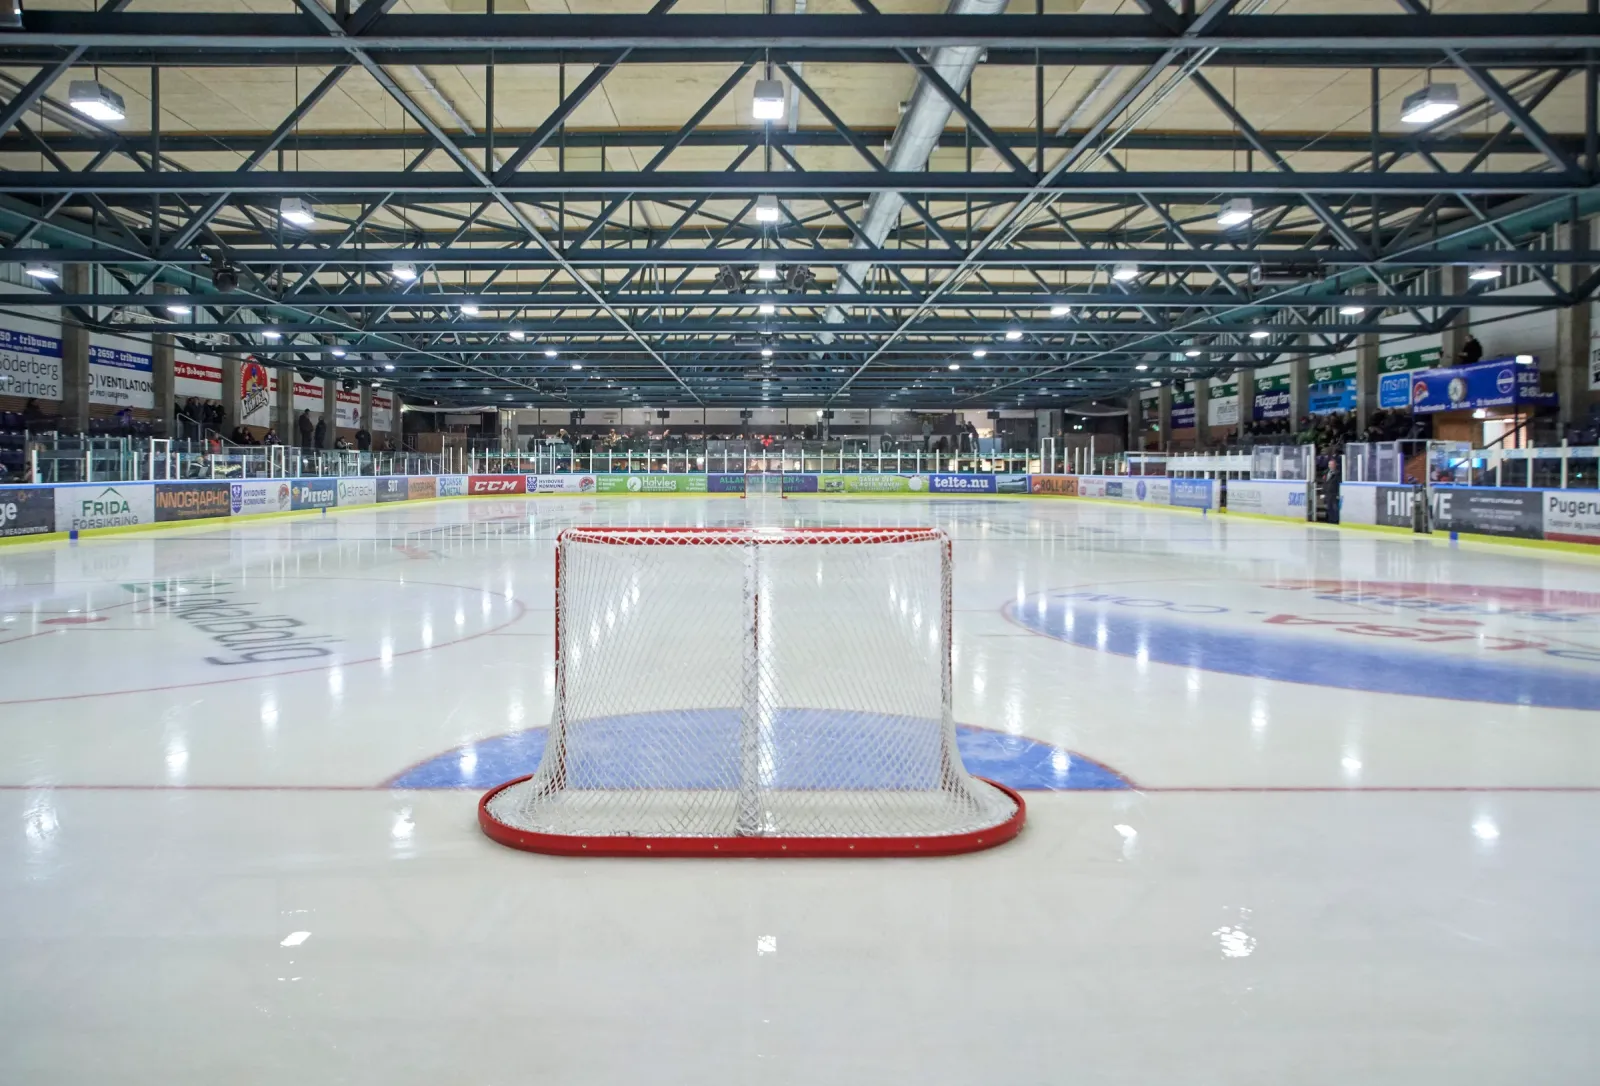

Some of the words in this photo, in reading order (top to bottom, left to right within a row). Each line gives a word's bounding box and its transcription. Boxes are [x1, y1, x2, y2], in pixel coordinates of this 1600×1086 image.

[20, 334, 58, 349] tribunen
[97, 348, 115, 360] 2650
[120, 352, 149, 365] tribunen
[0, 354, 59, 381] öderberg
[8, 374, 57, 397] Partners
[100, 374, 154, 393] VENTILATION
[474, 480, 519, 491] CCM
[934, 476, 990, 489] telte.nu
[82, 500, 131, 516] FRIDA
[72, 515, 139, 530] FORSIKRING
